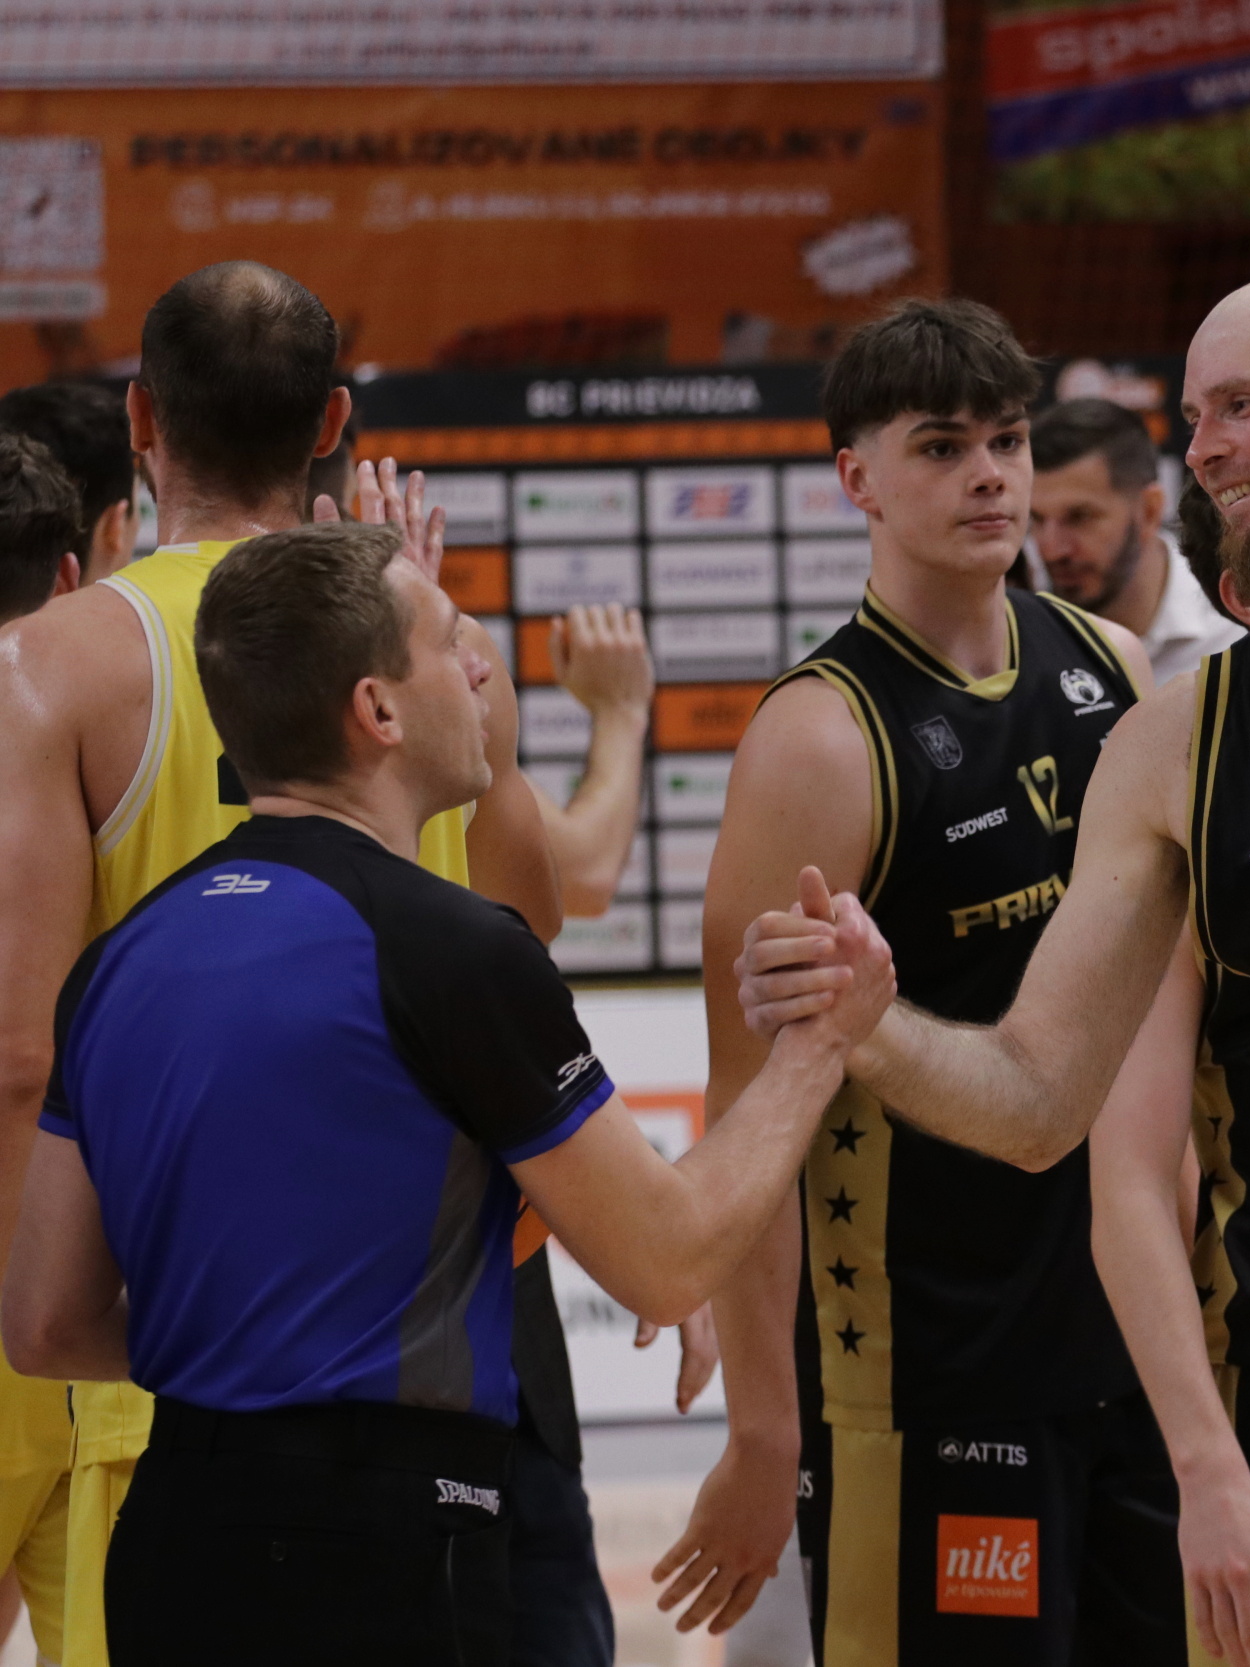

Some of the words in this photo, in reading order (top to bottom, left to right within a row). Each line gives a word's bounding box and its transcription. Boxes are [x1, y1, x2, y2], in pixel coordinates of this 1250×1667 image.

[526, 380, 575, 416] BC
[582, 376, 761, 415] PRIEVIDZA
[1017, 755, 1074, 836] 12
[945, 807, 1009, 843] SÜDWEST
[965, 1441, 1028, 1466] ATTIS
[945, 1535, 1032, 1582] niké
